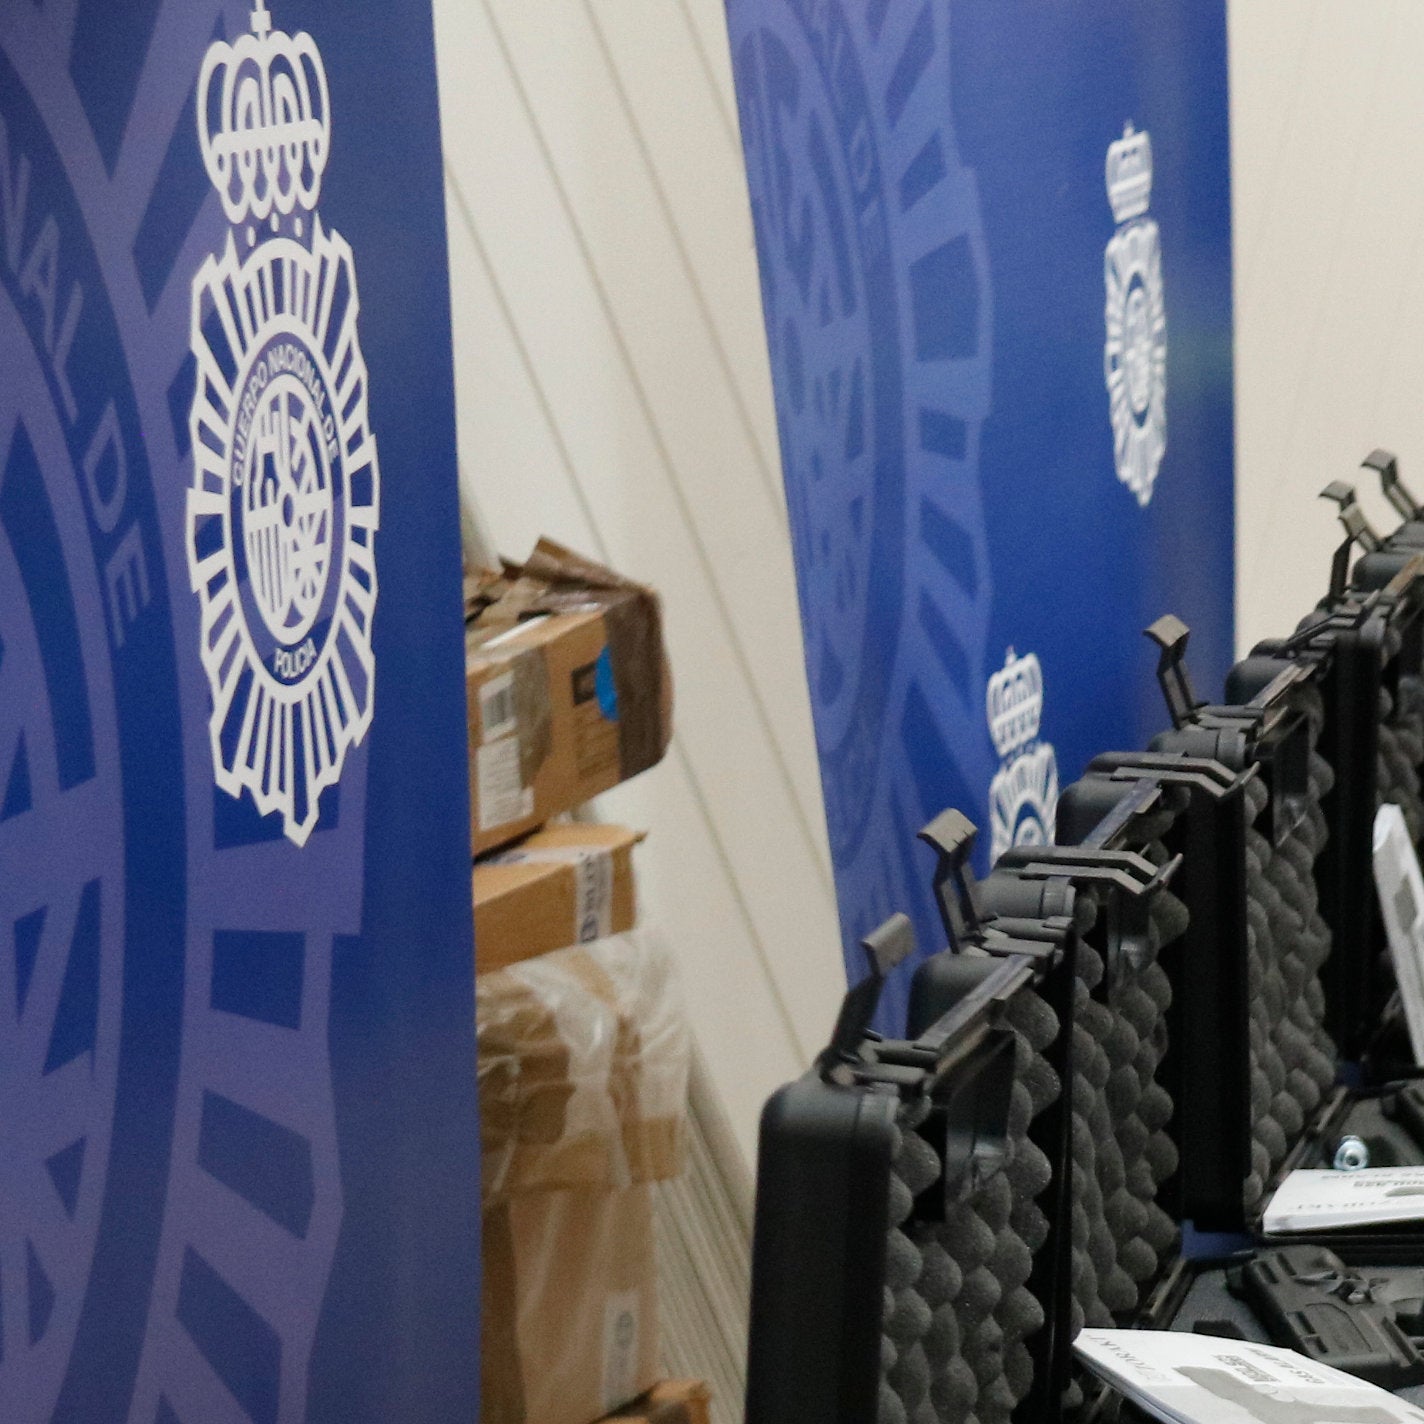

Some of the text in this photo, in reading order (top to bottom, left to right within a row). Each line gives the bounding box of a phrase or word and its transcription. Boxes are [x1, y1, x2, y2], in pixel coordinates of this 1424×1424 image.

[232, 361, 268, 486] CUERPO
[266, 344, 326, 419] NACIONAL
[273, 637, 318, 678] POLICIA
